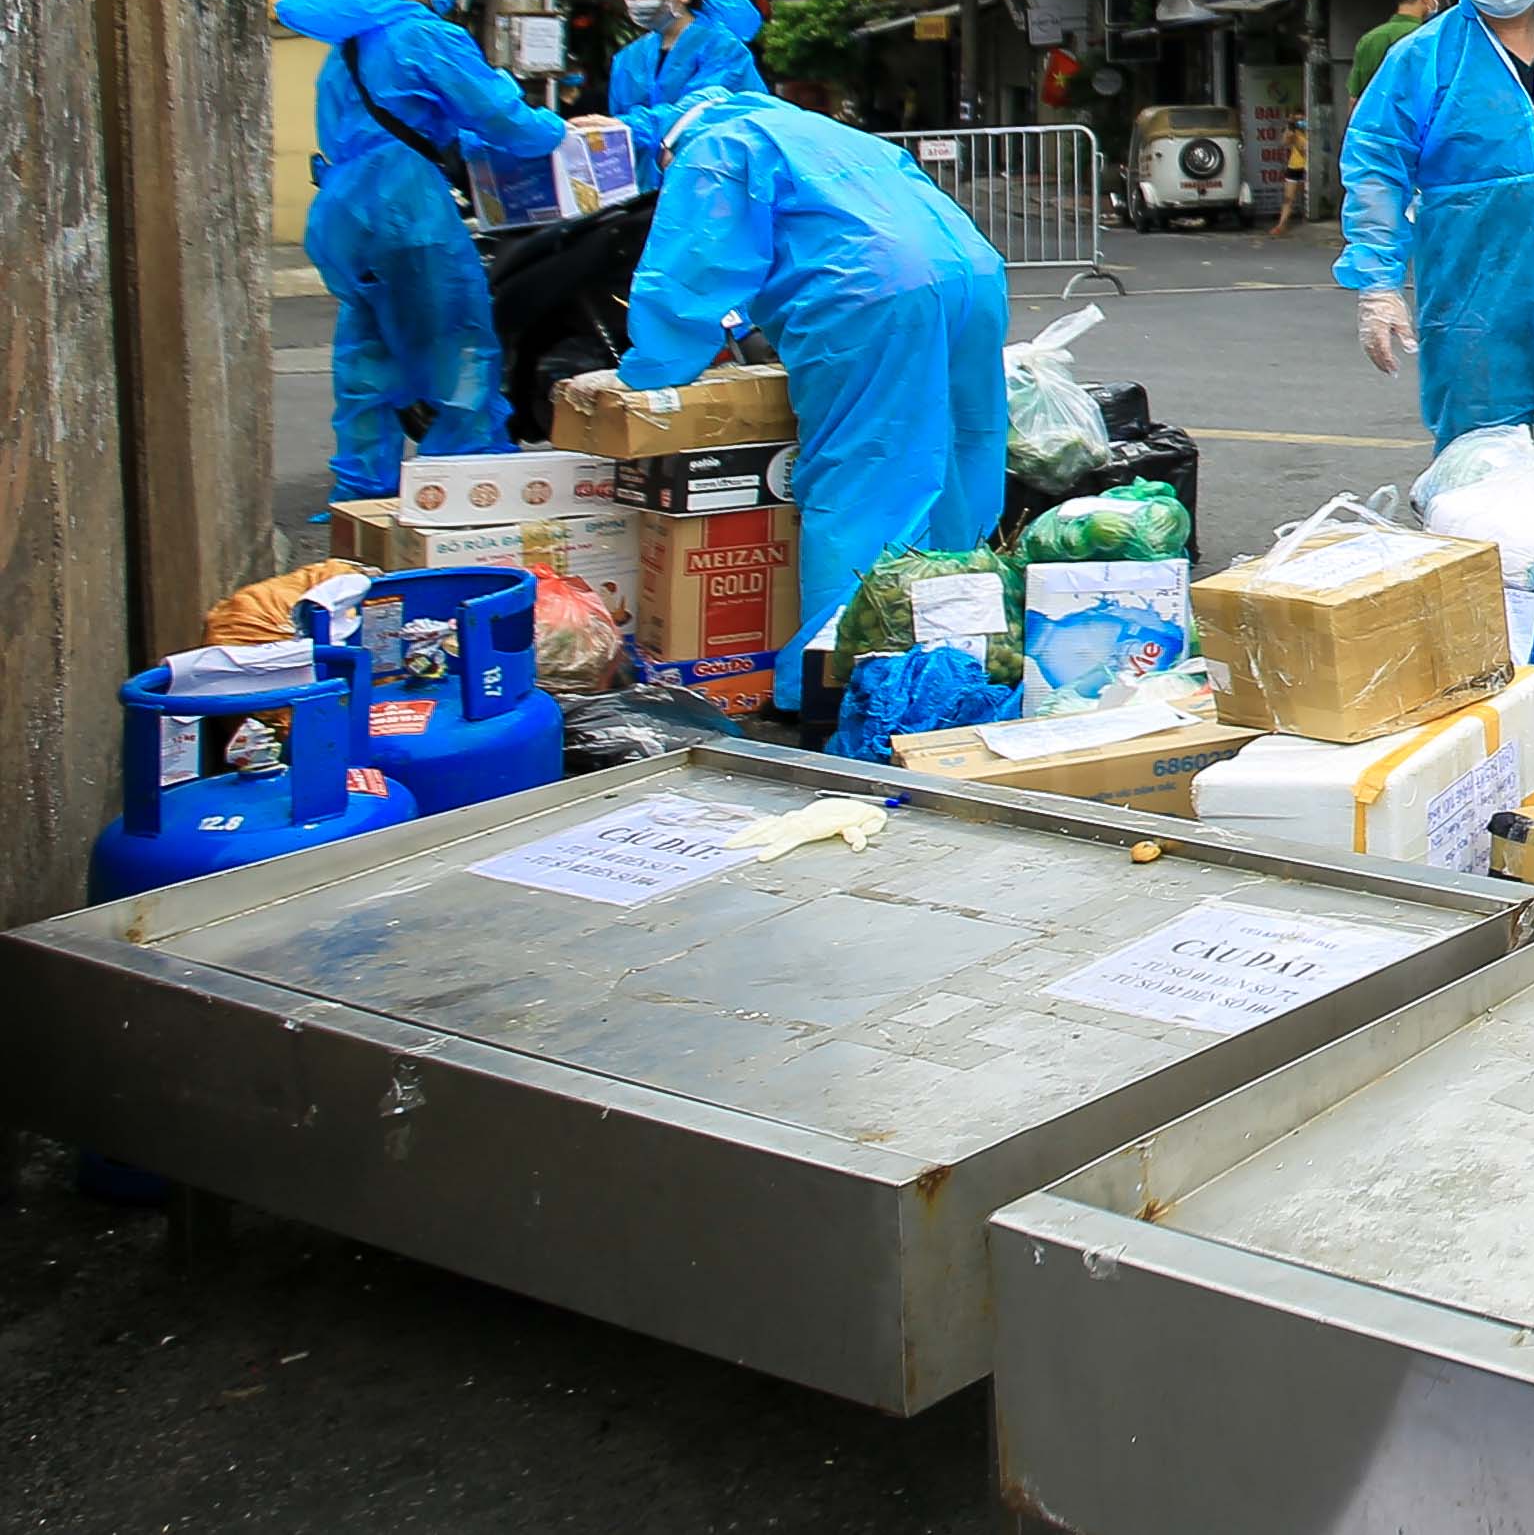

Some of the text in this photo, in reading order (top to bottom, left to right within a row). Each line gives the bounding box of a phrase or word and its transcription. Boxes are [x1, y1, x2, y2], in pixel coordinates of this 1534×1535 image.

[689, 542, 785, 572] MEIZAN
[710, 572, 764, 597] GOLD
[1172, 939, 1241, 964] CẦU
